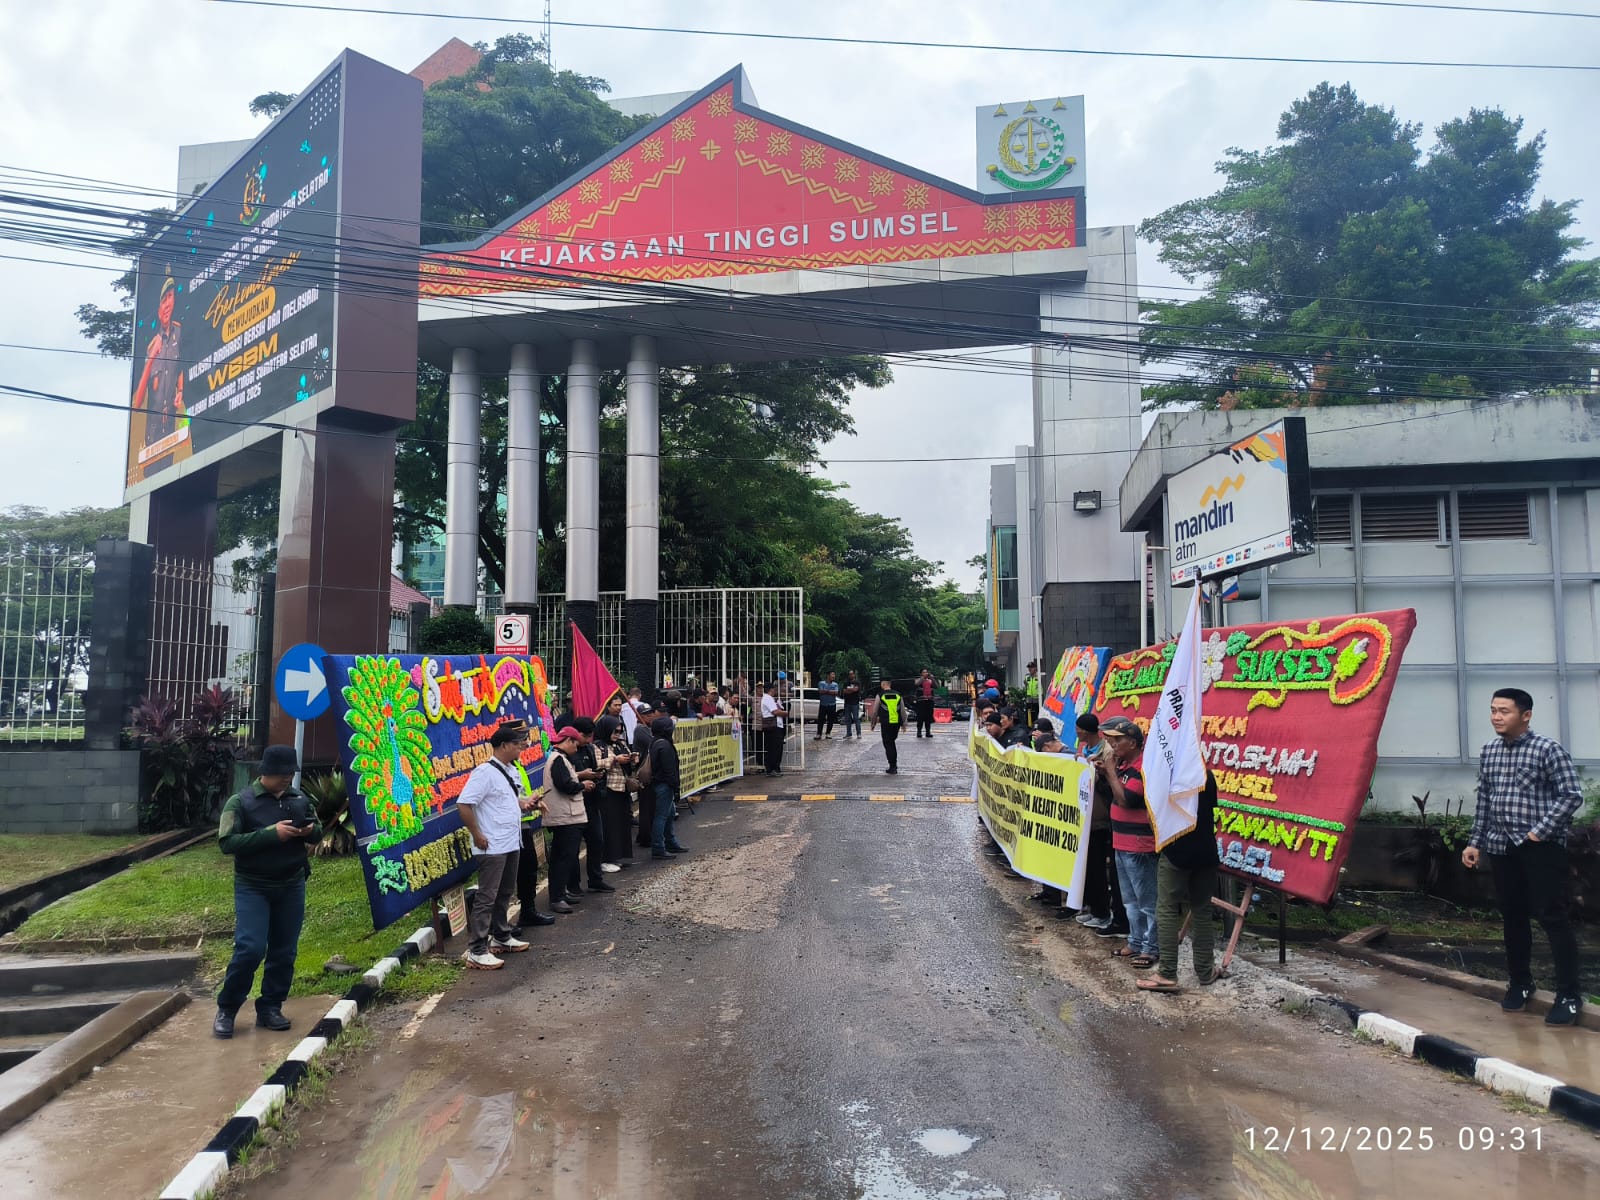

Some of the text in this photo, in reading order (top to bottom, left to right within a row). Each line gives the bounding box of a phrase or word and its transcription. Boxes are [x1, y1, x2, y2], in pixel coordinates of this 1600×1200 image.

[297, 168, 329, 205] SELATAN
[499, 211, 959, 269] KEJAKSAAN TINGGI SUMSEL
[189, 355, 212, 381] WILAYAH
[244, 320, 267, 346] BERSIH
[268, 310, 281, 331] DAN
[282, 284, 319, 322] MELAYANI
[228, 296, 270, 336] MEWUJUDKAN
[208, 333, 278, 391] WBBM
[208, 381, 236, 408] KEJAKSAAN
[238, 370, 256, 391] TINGGI
[256, 351, 288, 380] SUMATERA
[289, 333, 318, 361] SELATAN
[229, 382, 262, 412] TAHUN 2025
[1175, 500, 1234, 542] mandiri
[1175, 541, 1197, 561] atm
[503, 623, 513, 639] 5
[1111, 646, 1337, 692] SELAMAT SUKSES
[1032, 795, 1057, 819] KEJATI
[1035, 823, 1061, 847] TAHUN
